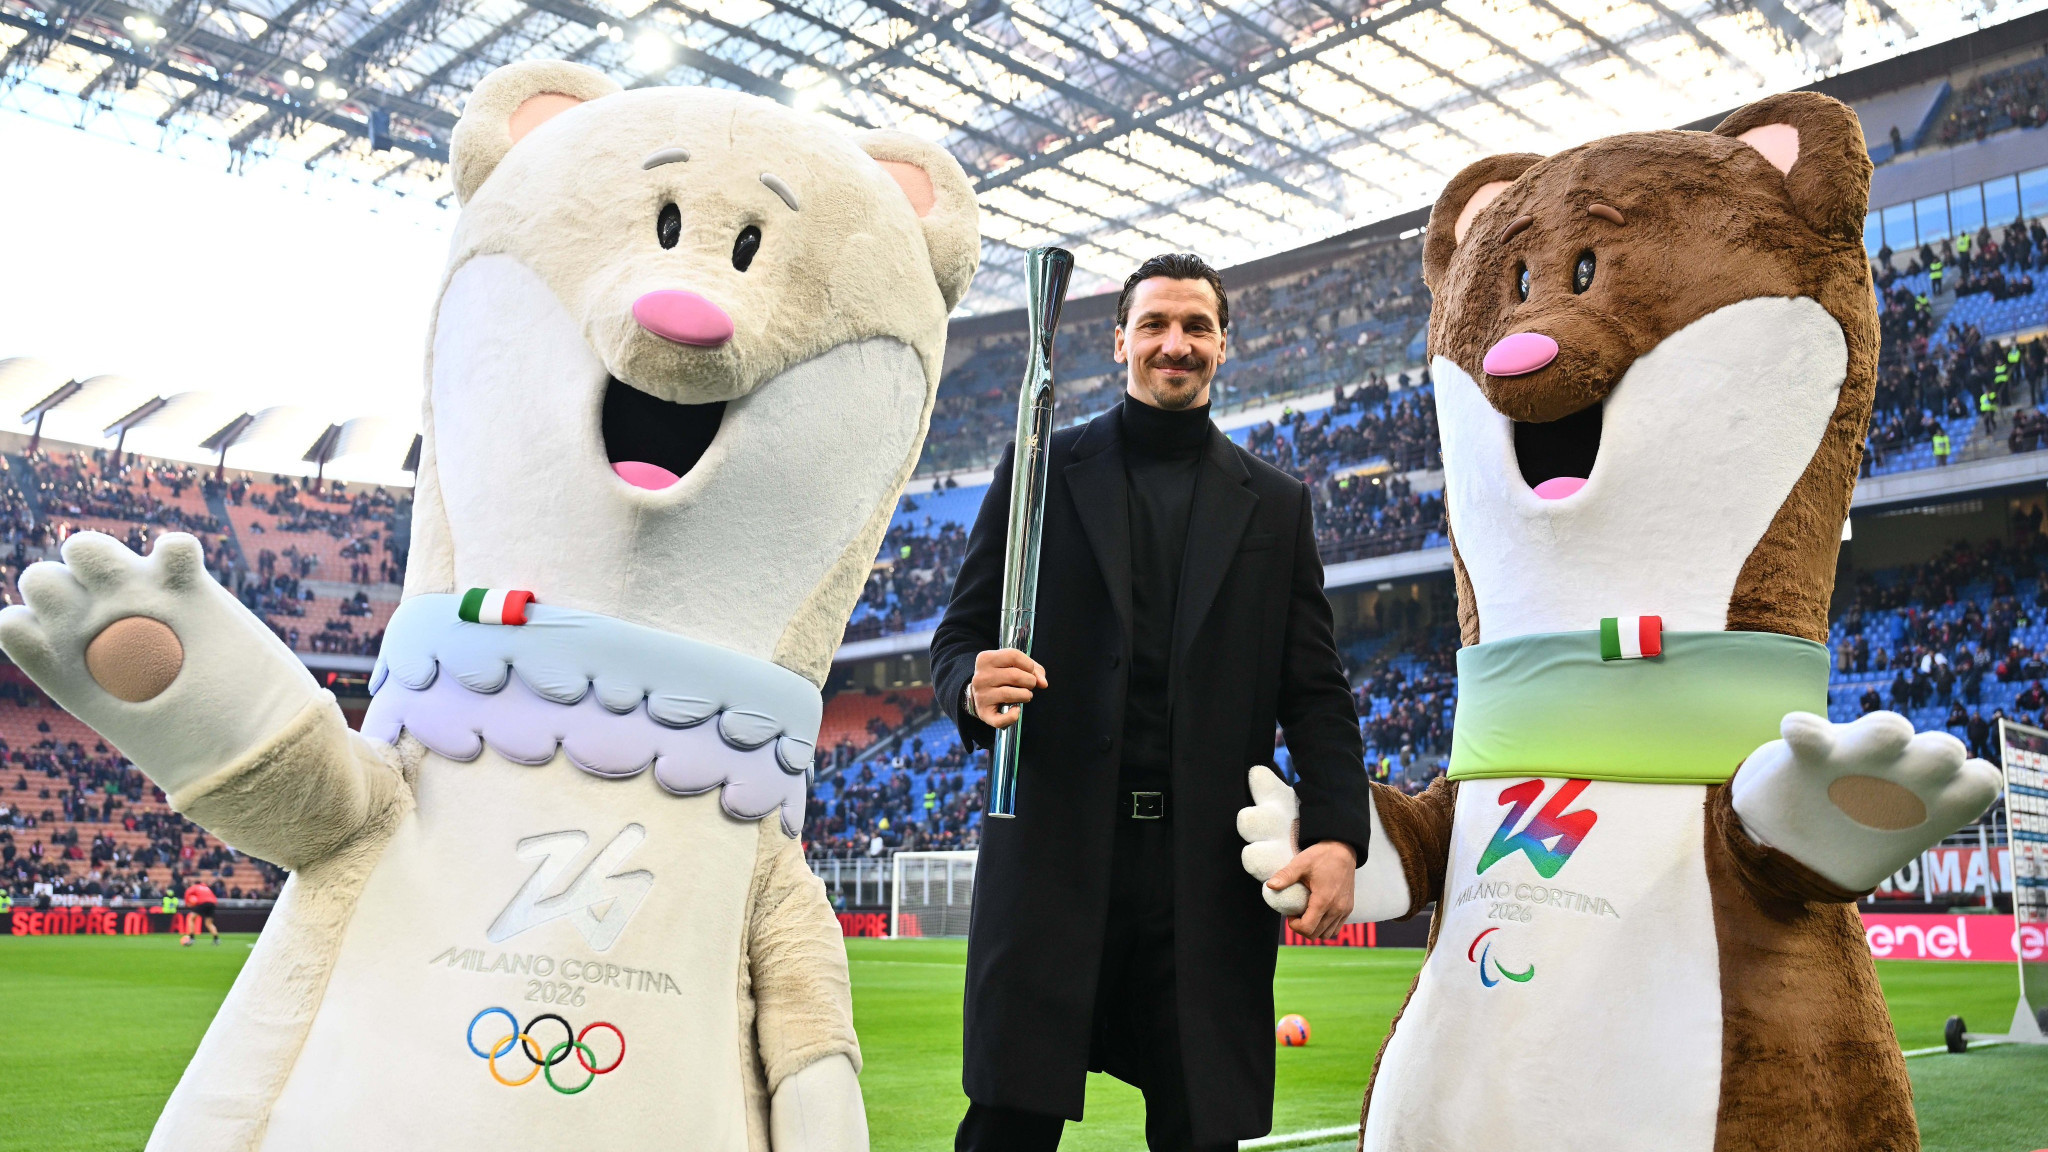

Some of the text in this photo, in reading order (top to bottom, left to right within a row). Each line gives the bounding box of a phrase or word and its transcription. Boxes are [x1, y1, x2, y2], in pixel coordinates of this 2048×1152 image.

[1476, 778, 1598, 879] 26
[486, 822, 655, 953] 26
[1455, 881, 1621, 919] MILANO CORTINA
[11, 911, 118, 936] SEMPRE
[1488, 902, 1532, 923] 2026
[1866, 916, 1972, 958] enel
[429, 946, 683, 995] MILANO CORTINA
[524, 979, 586, 1008] 2026
